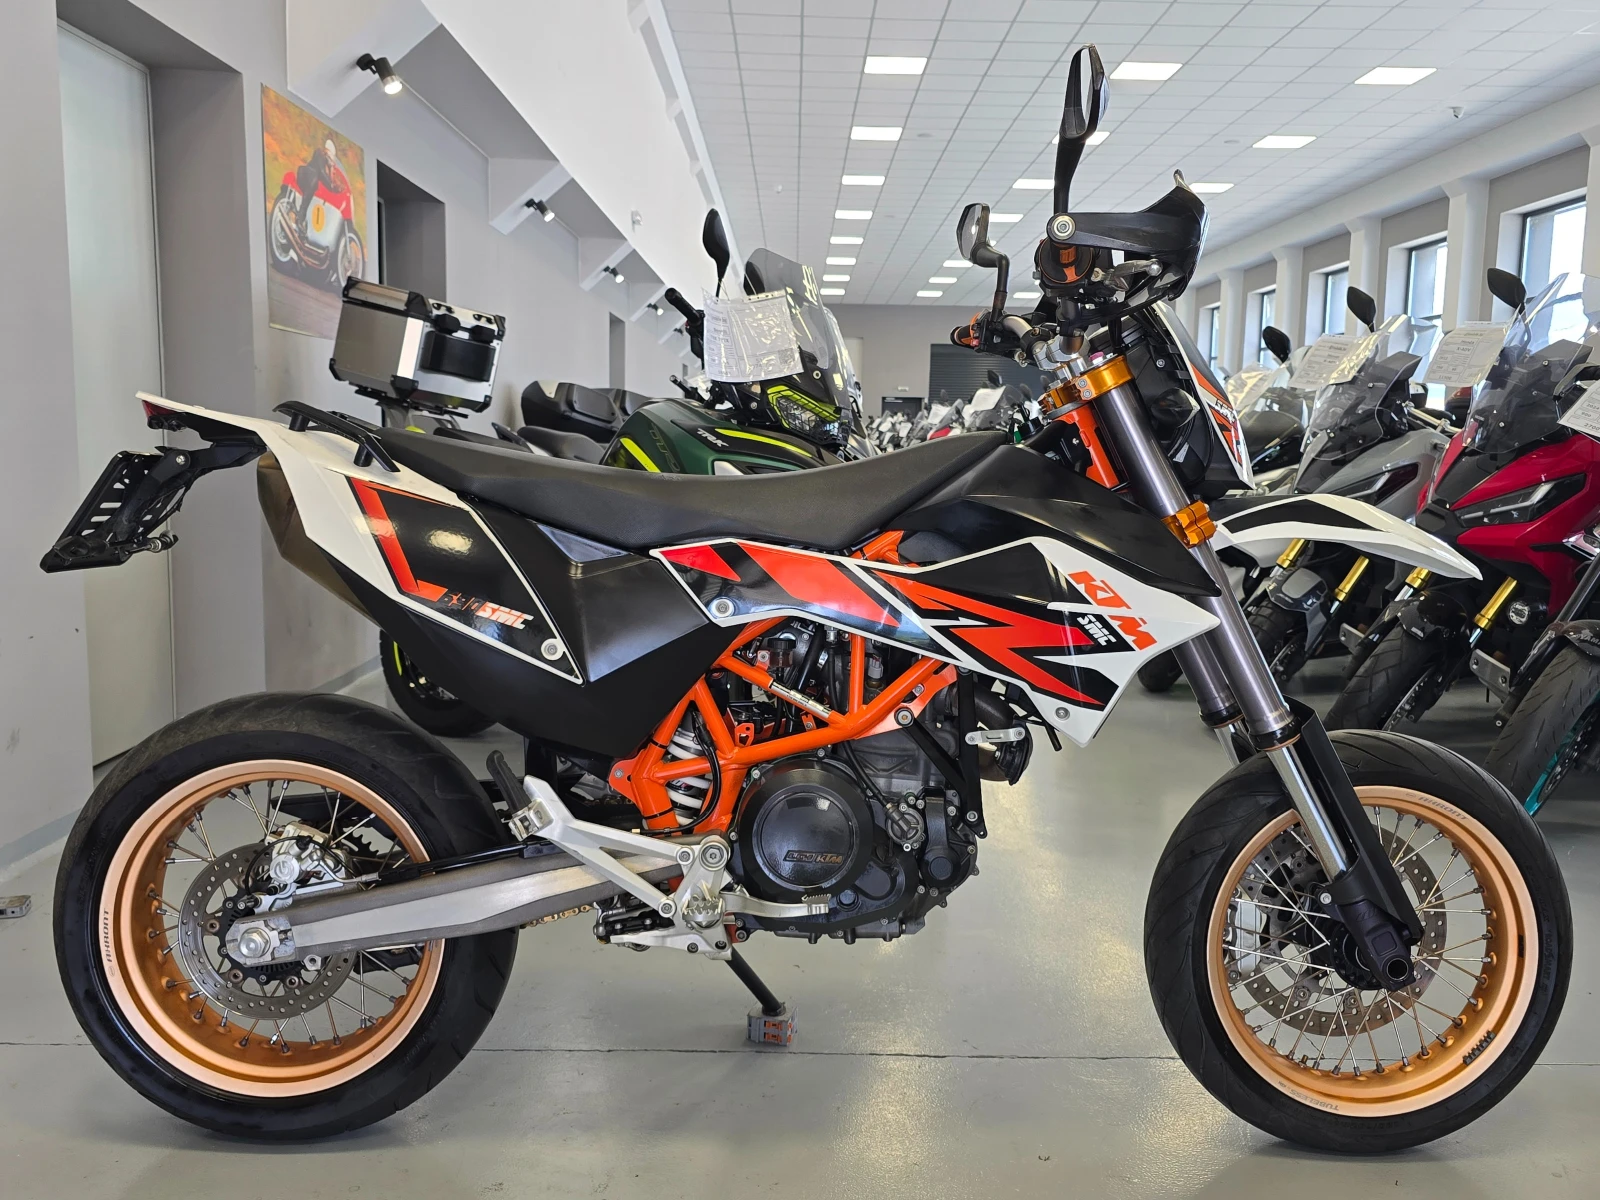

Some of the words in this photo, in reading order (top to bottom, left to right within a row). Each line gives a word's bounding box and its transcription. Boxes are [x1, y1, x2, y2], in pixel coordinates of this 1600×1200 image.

[696, 427, 730, 448] TRK
[475, 601, 535, 630] SMC
[1066, 570, 1158, 651] KTM
[1076, 614, 1118, 647] SMC
[1580, 633, 1600, 645] YAM
[815, 853, 844, 864] KTM
[1289, 1089, 1340, 1112] TUBELESS
